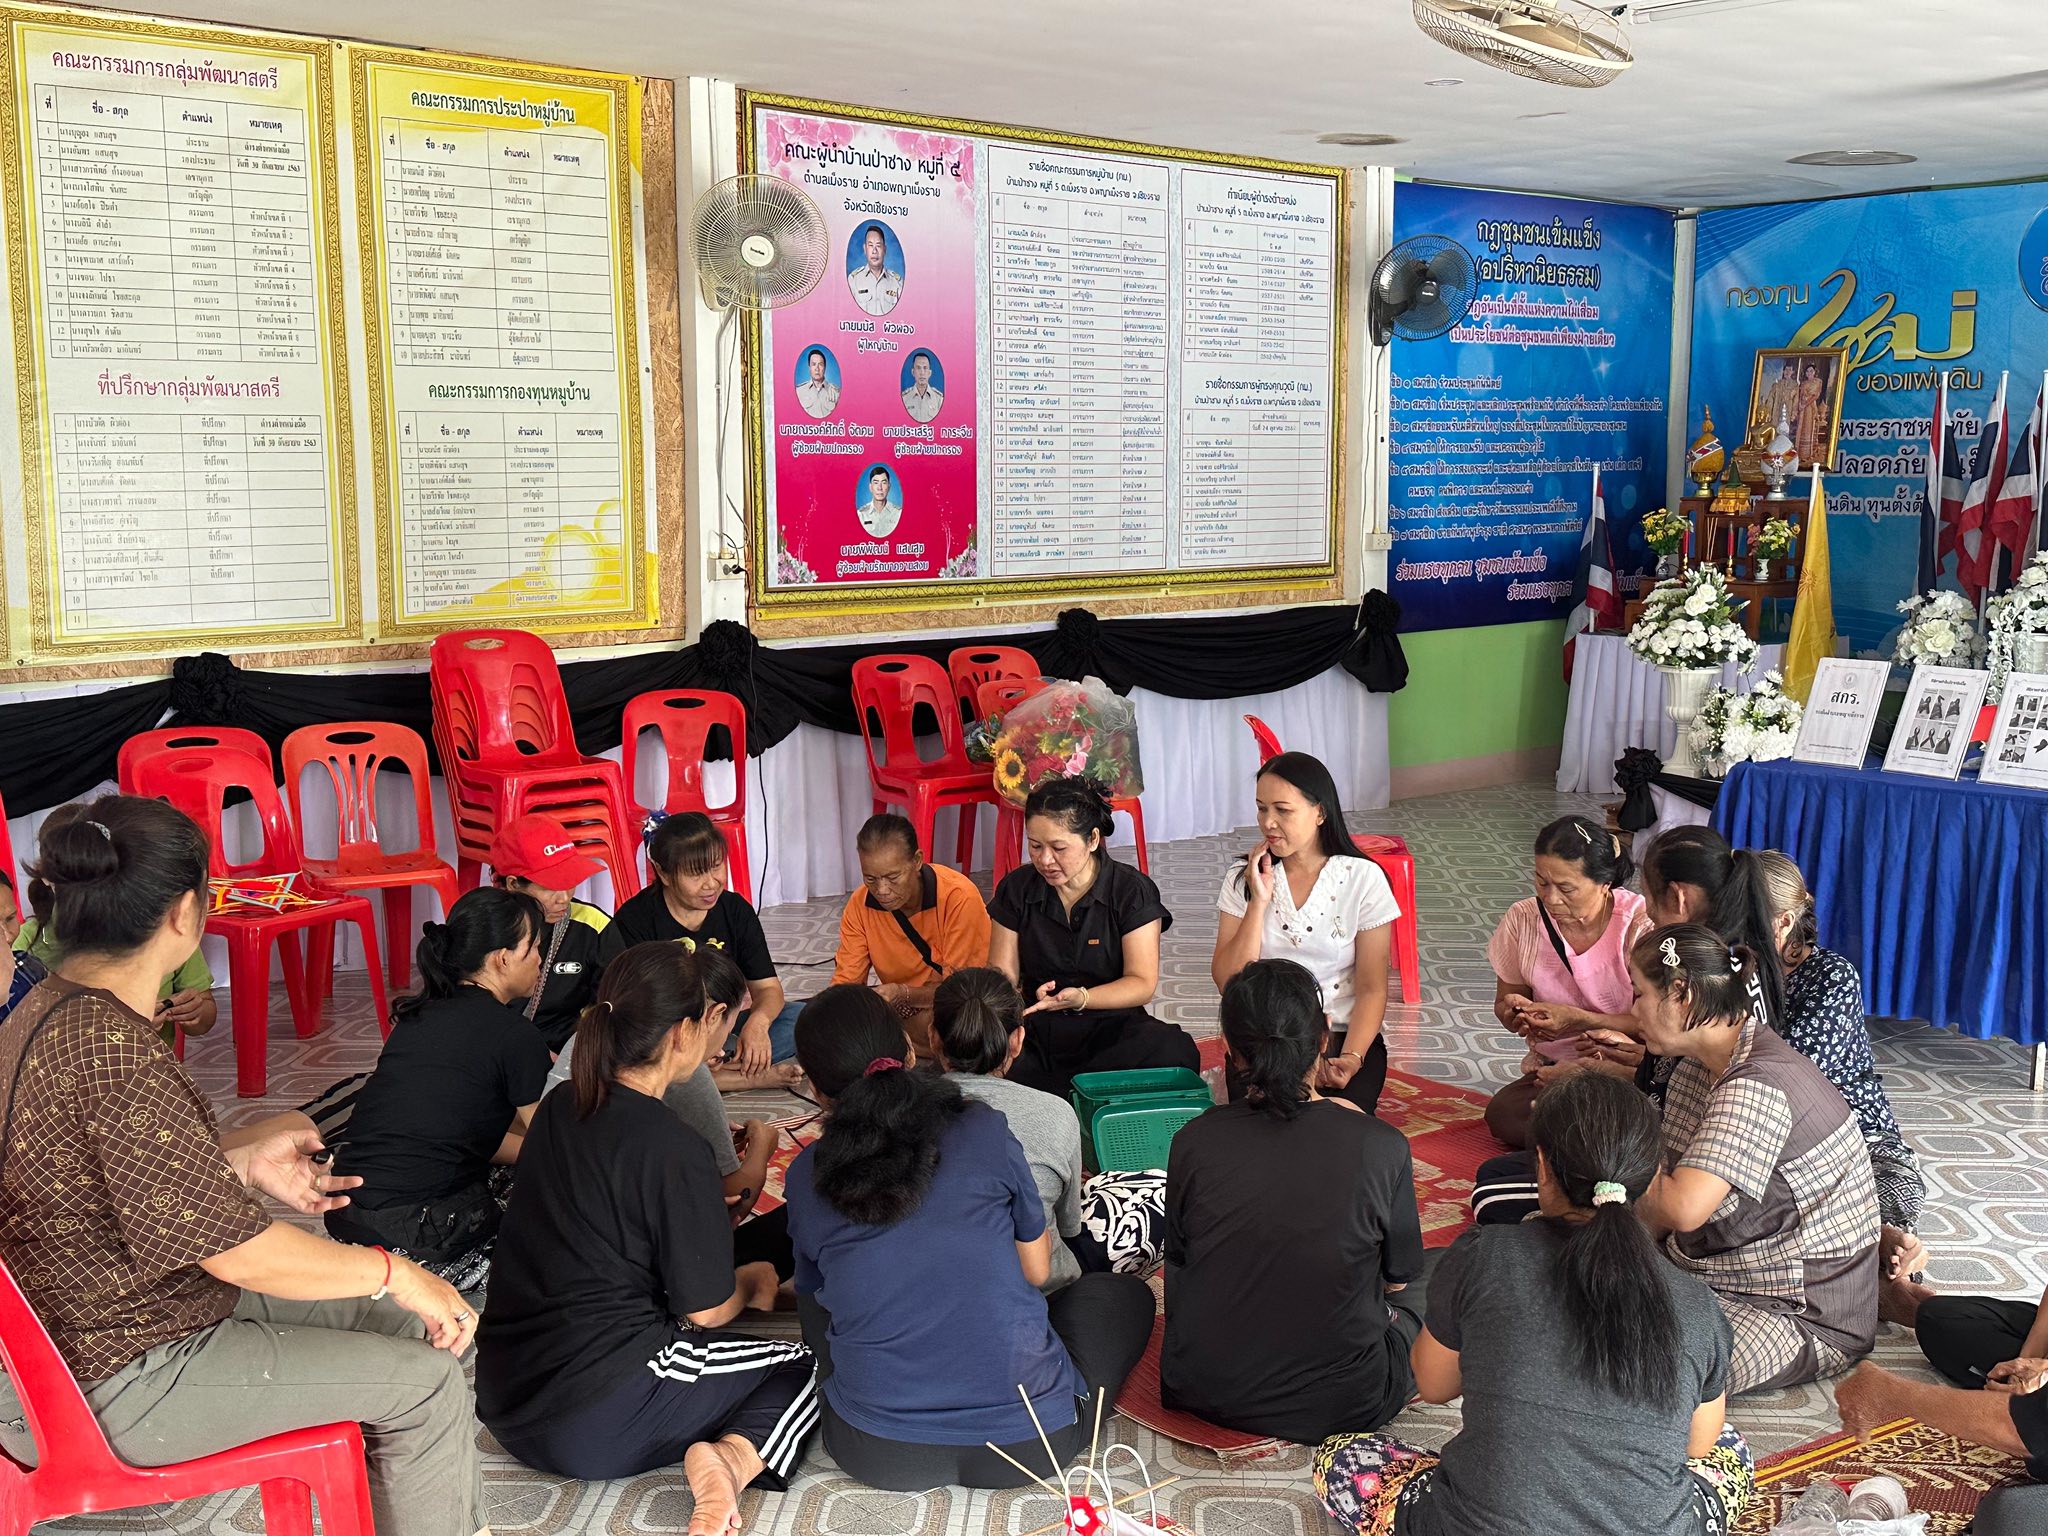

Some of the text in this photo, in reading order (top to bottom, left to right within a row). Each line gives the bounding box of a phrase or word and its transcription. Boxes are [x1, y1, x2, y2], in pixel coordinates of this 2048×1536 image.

[52, 51, 278, 89] คณะกรรมการกลุ่มพัฒนาสตรี
[92, 100, 128, 118] ชื่อ สกุล
[182, 111, 212, 123] ตำแหน่ง
[411, 91, 575, 126] คณะกรรมการประปาหมู่บ้าน
[249, 119, 282, 133] หมายเหตุ
[426, 137, 435, 149] ชื่อ
[504, 147, 530, 158] ตำแหน่ง
[553, 154, 580, 166] หมายเหตุ
[785, 142, 961, 181] คณะผู้นำบ้านป่าซาง หมู่ที่ ๕
[1029, 159, 1114, 181] รายชื่อคณะกรรมการหมู่บ้าน
[804, 169, 940, 197] ตำบลเม็งราย อำเภอพญาเม็งราย
[844, 198, 909, 216] จังหวัดเชียงราย
[1477, 216, 1601, 252] กฎชุมชนเข้มแข็ง
[1476, 256, 1601, 290] (อปริหานิยธรรม)
[1726, 283, 1809, 312] กองทุน
[97, 368, 280, 403] ที่ปรึกษากลุ่มพัฒนาสตรี
[429, 380, 590, 407] คณะกรรมการกองทุนหมูบ้าน
[440, 424, 450, 436] ชื่อ
[518, 426, 542, 436] ตำแหน่ง
[1840, 412, 1978, 437] พระราชหทัย
[1395, 547, 1548, 584] ร่วมแรงทุกคน ชุมชนเข้มแข็ง
[1830, 691, 1860, 705] สกร.
